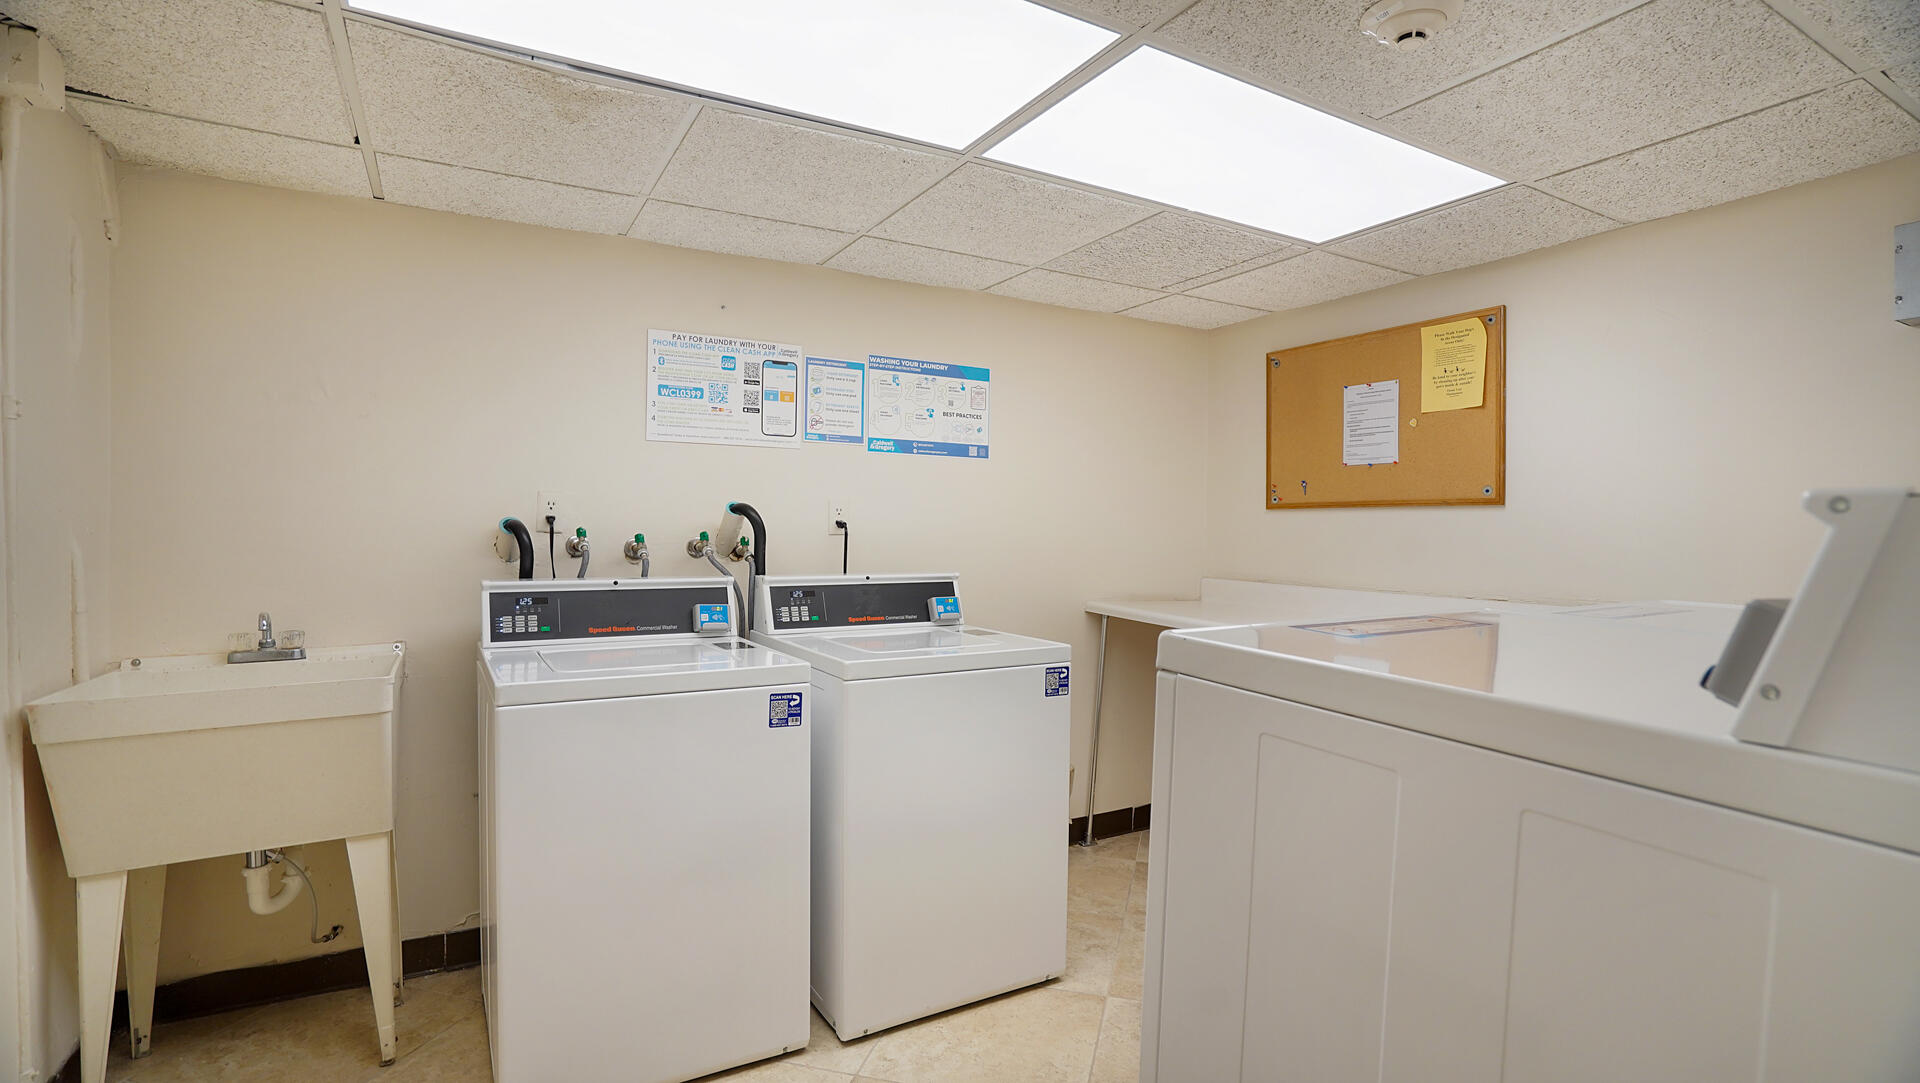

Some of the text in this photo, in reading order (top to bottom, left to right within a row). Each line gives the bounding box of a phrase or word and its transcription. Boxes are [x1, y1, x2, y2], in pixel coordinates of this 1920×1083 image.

[652, 339, 677, 348] PHONE
[680, 342, 702, 350] USING
[718, 346, 740, 355] CLEAN
[705, 337, 737, 347] LAUNDRY
[869, 356, 900, 366] WASHING
[920, 362, 948, 371] LAUNDRY
[660, 388, 701, 399] WCL0399
[588, 626, 611, 634] Speed
